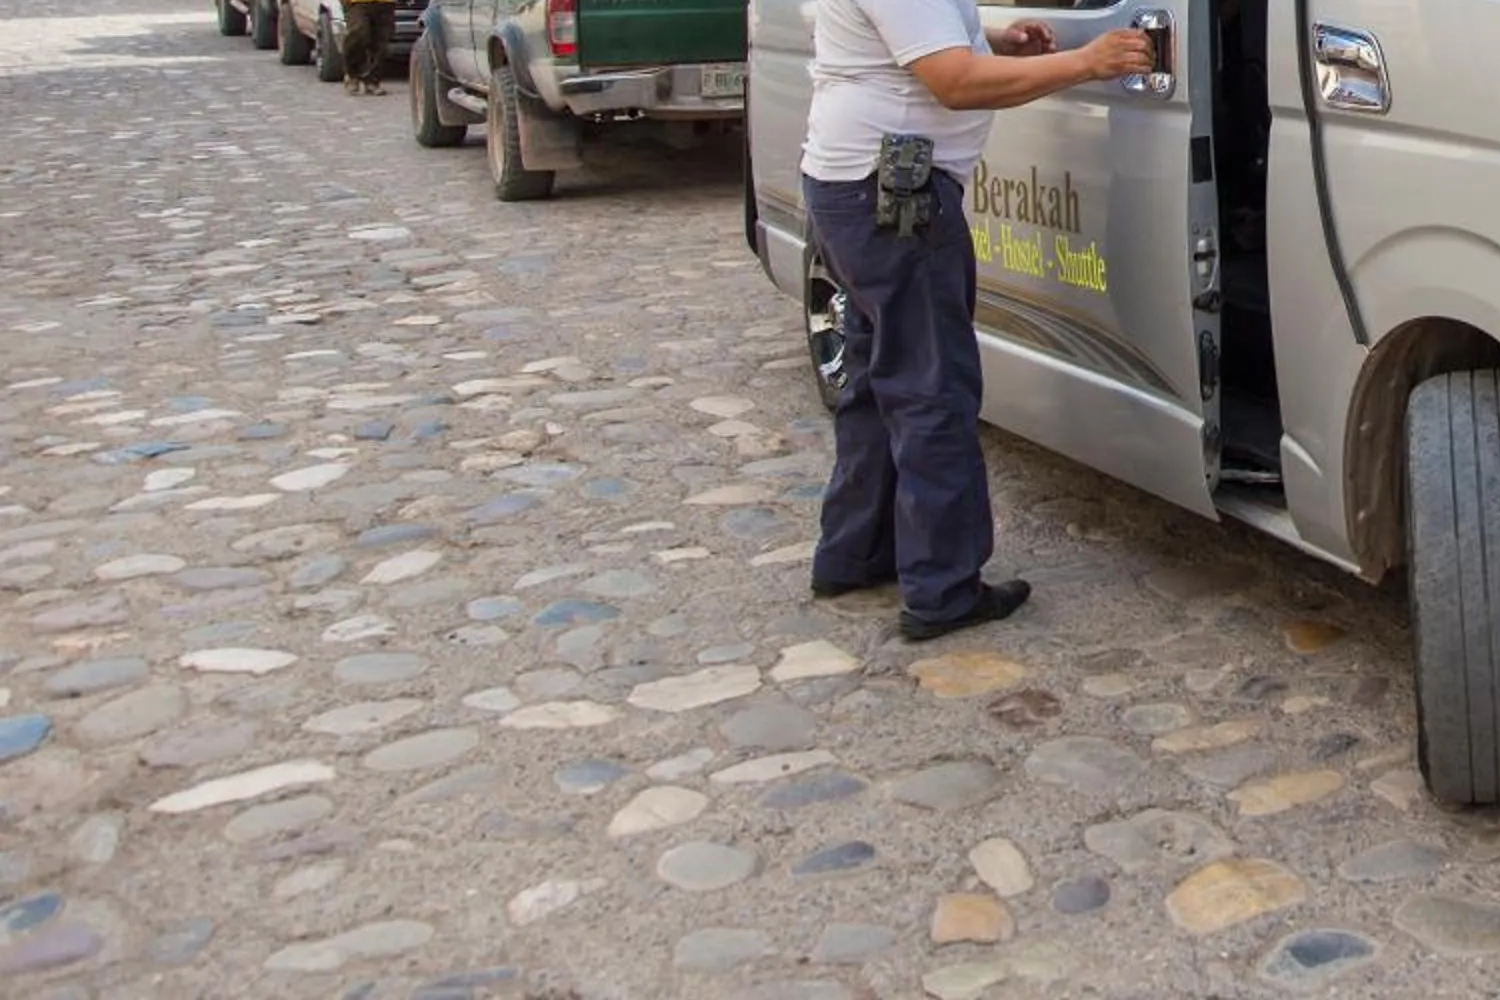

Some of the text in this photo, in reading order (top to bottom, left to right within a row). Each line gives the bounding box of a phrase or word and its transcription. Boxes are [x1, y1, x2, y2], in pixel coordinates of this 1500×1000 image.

[974, 159, 1081, 233] Berakah
[1001, 223, 1044, 277] Hostel
[1056, 234, 1107, 292] Shuttle
